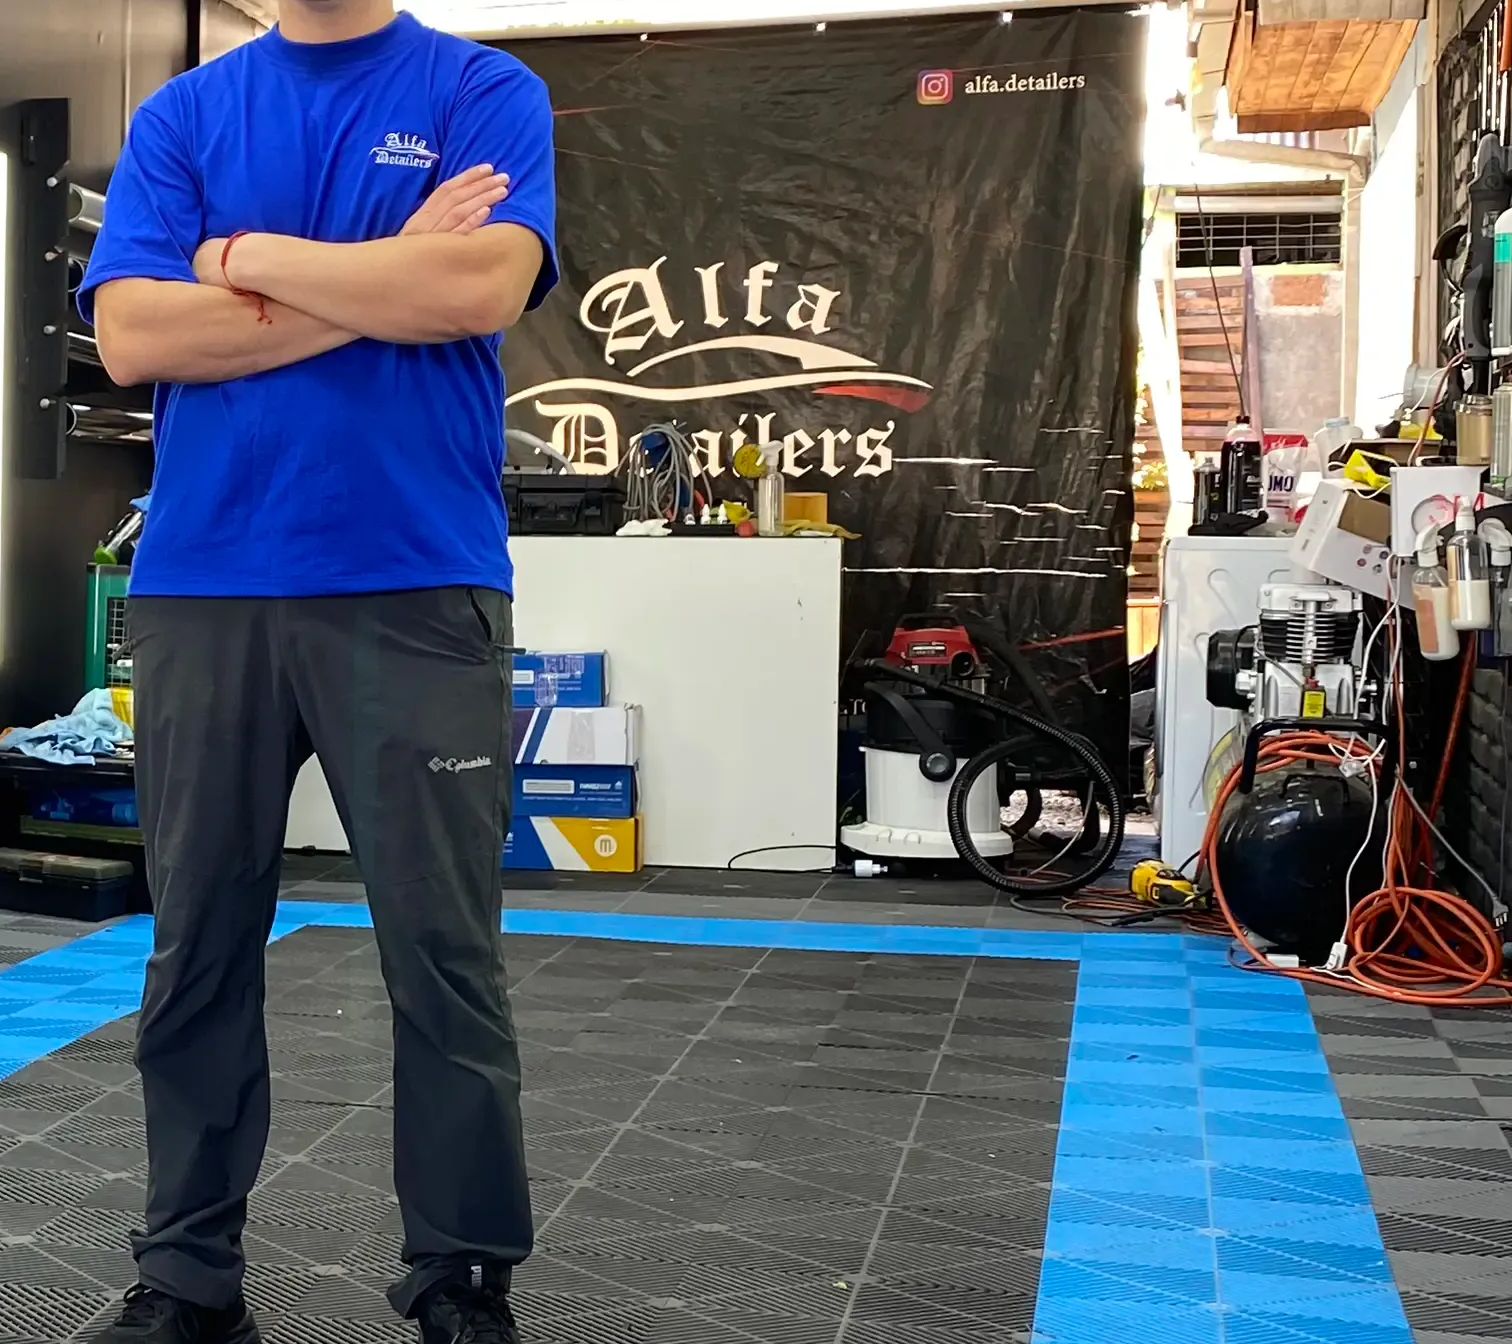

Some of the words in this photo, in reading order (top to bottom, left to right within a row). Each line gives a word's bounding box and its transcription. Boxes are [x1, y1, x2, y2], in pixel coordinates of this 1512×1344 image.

[964, 71, 1086, 94] alfa.detailers
[384, 131, 428, 149] Alfa
[579, 255, 841, 366] Alfa
